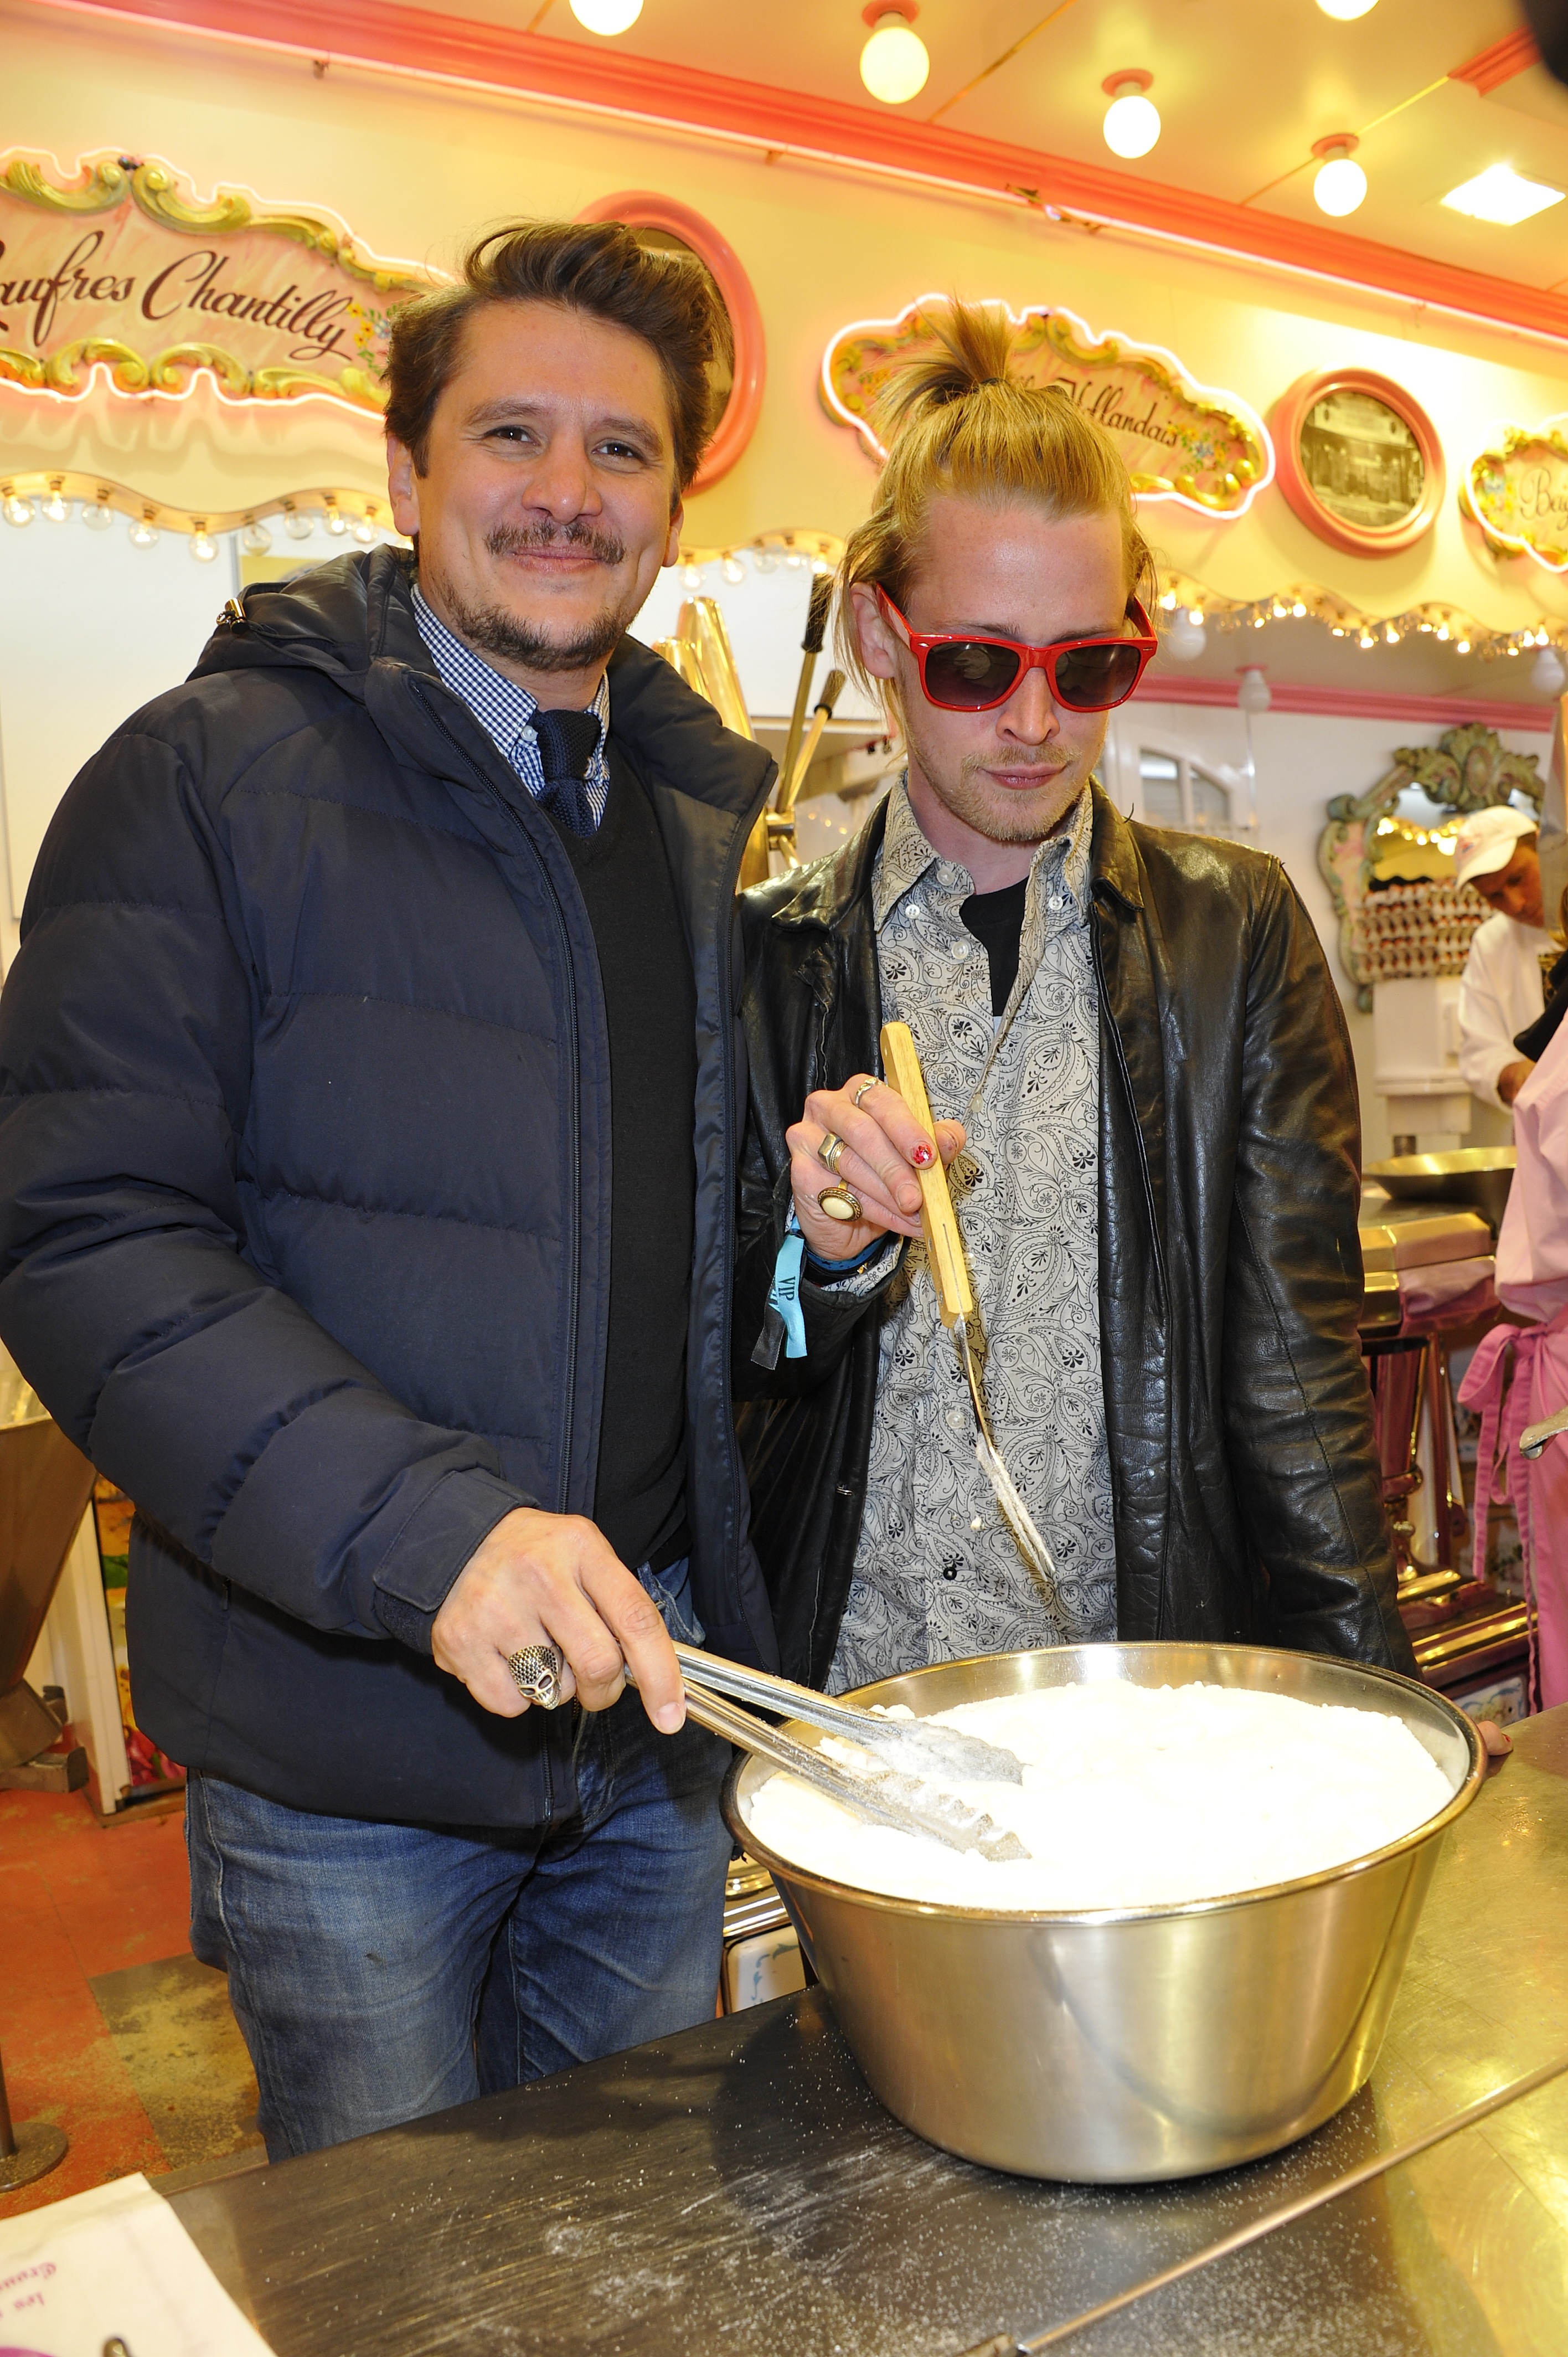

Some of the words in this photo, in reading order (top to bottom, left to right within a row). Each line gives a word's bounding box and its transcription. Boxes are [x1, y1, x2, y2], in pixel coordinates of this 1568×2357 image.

[0, 230, 136, 347] aufres
[141, 250, 353, 360] Chantilly
[778, 1276, 796, 1301] VIP
